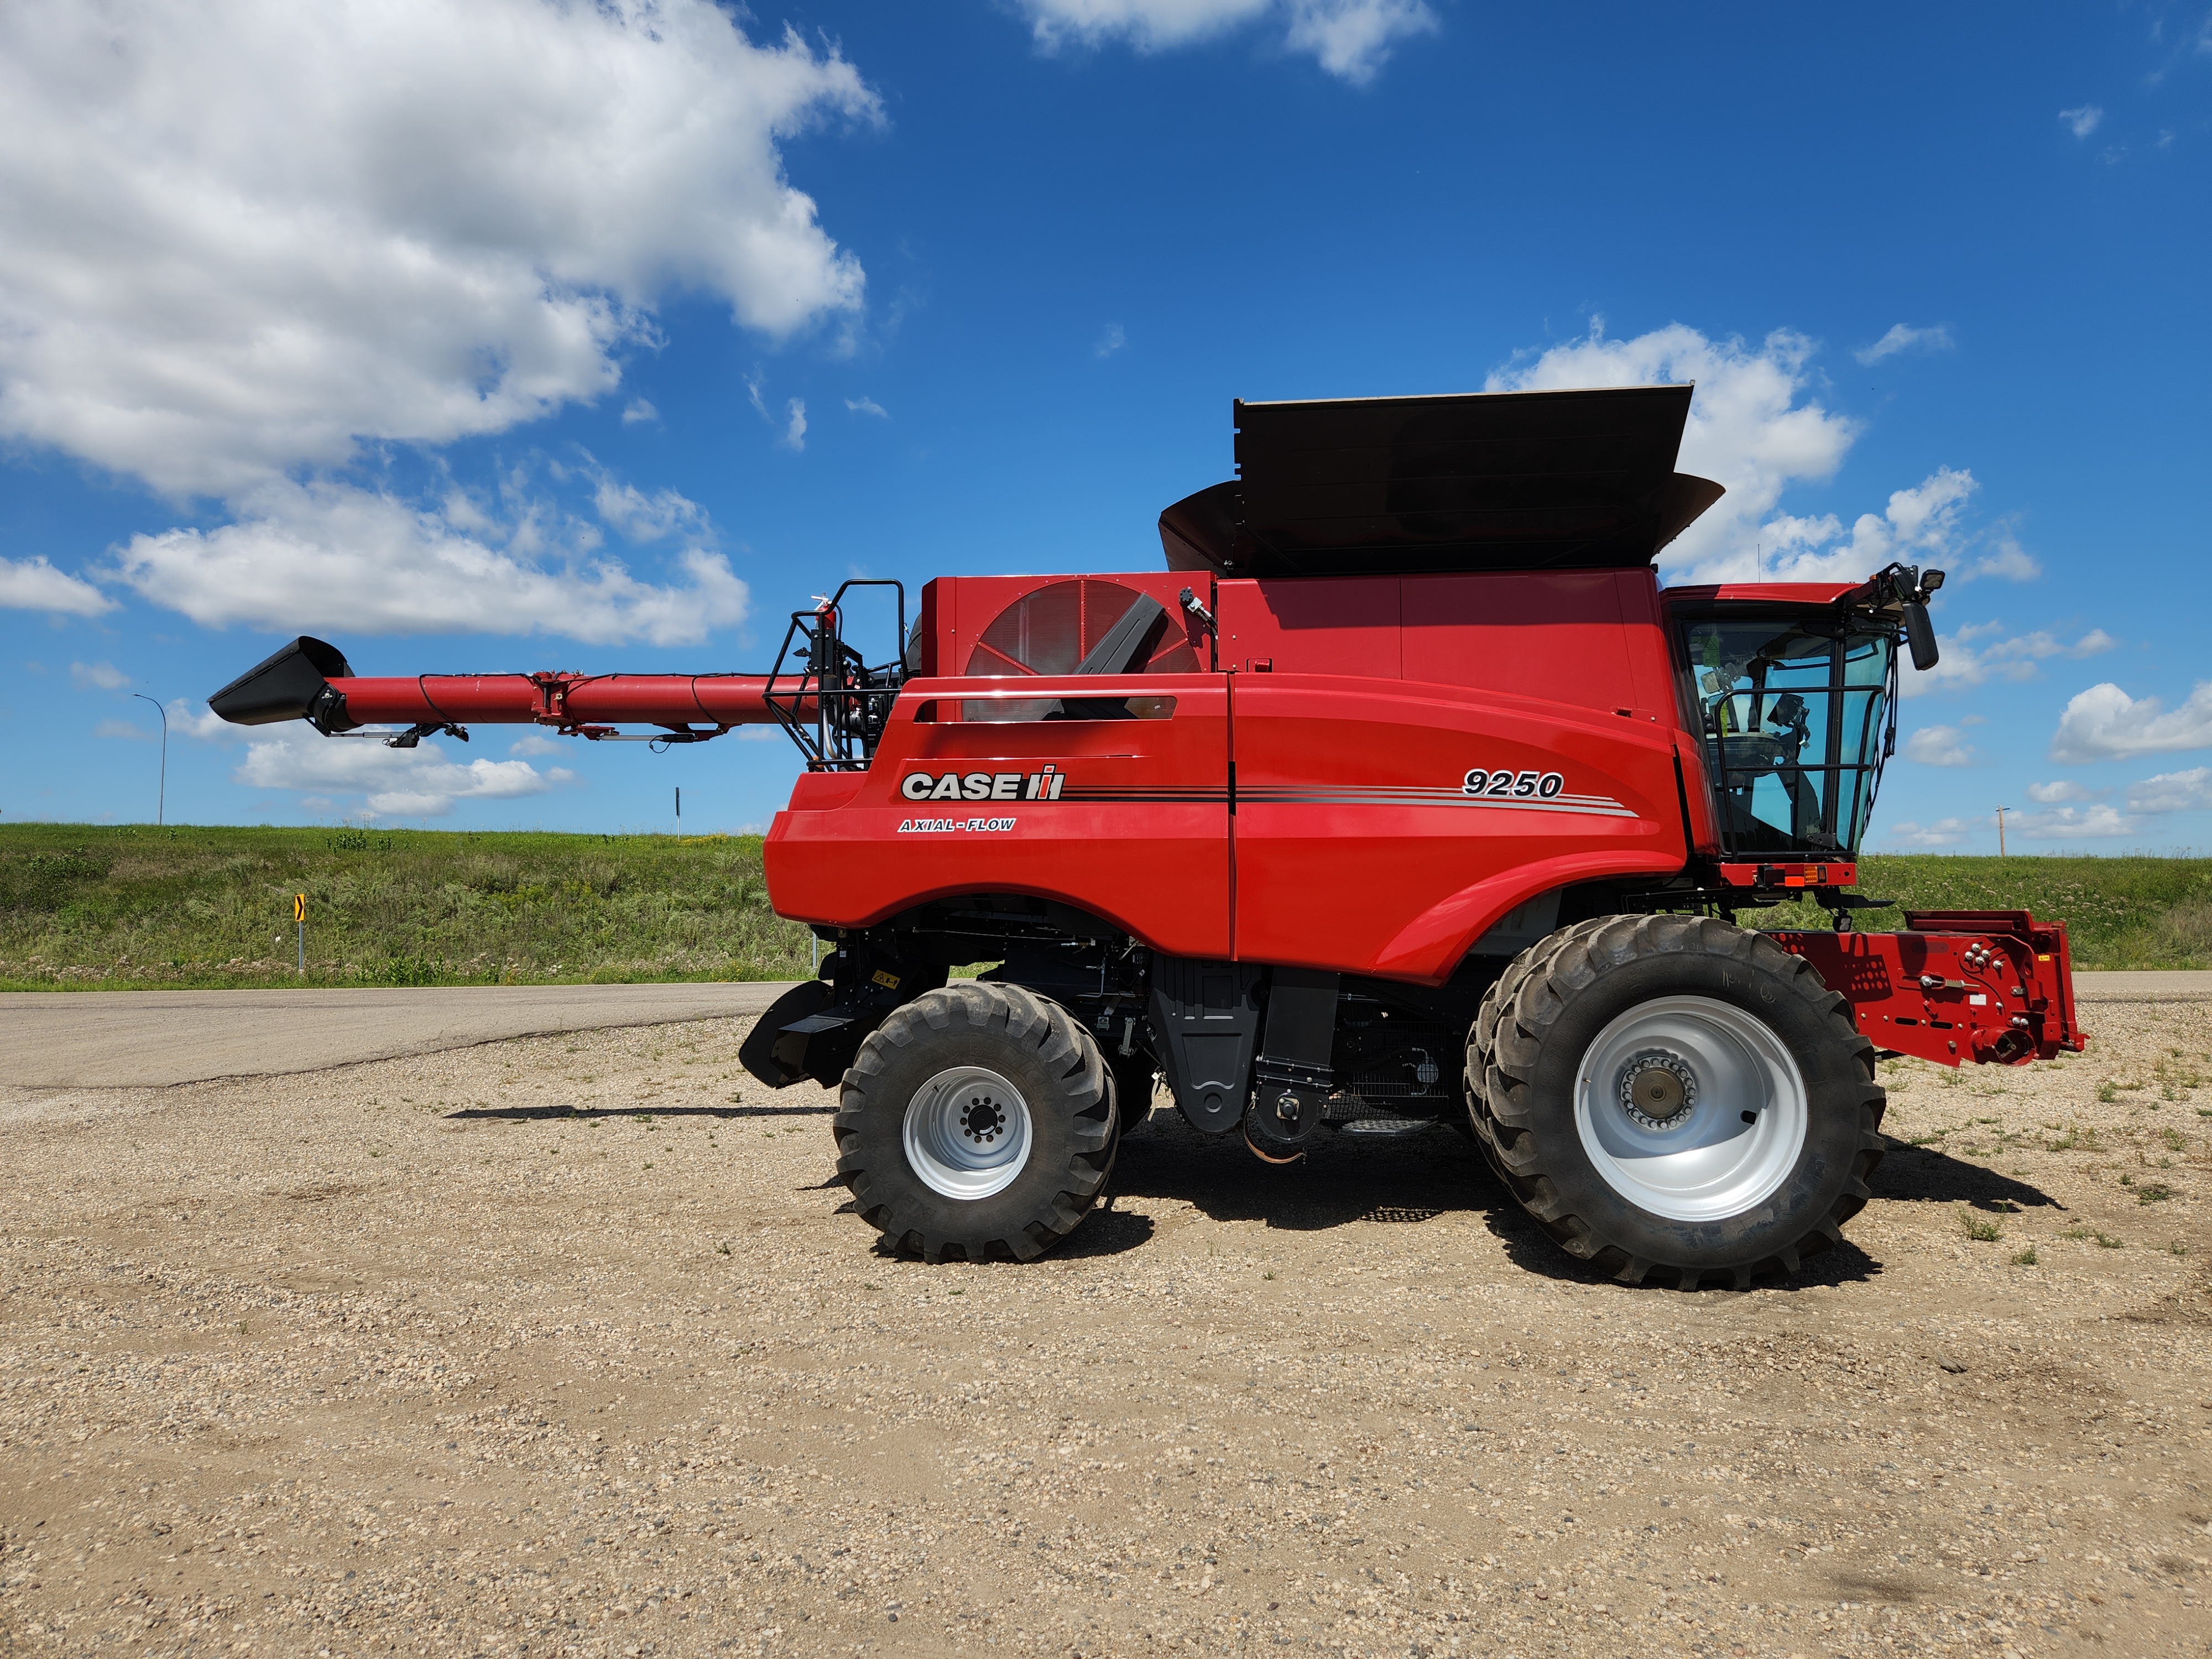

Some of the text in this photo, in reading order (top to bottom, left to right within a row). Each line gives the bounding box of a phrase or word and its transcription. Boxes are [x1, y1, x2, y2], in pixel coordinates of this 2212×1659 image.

[902, 773, 1022, 800] CASE
[1462, 768, 1564, 800] 9250
[898, 818, 1016, 833] AXIAL-FLOW
